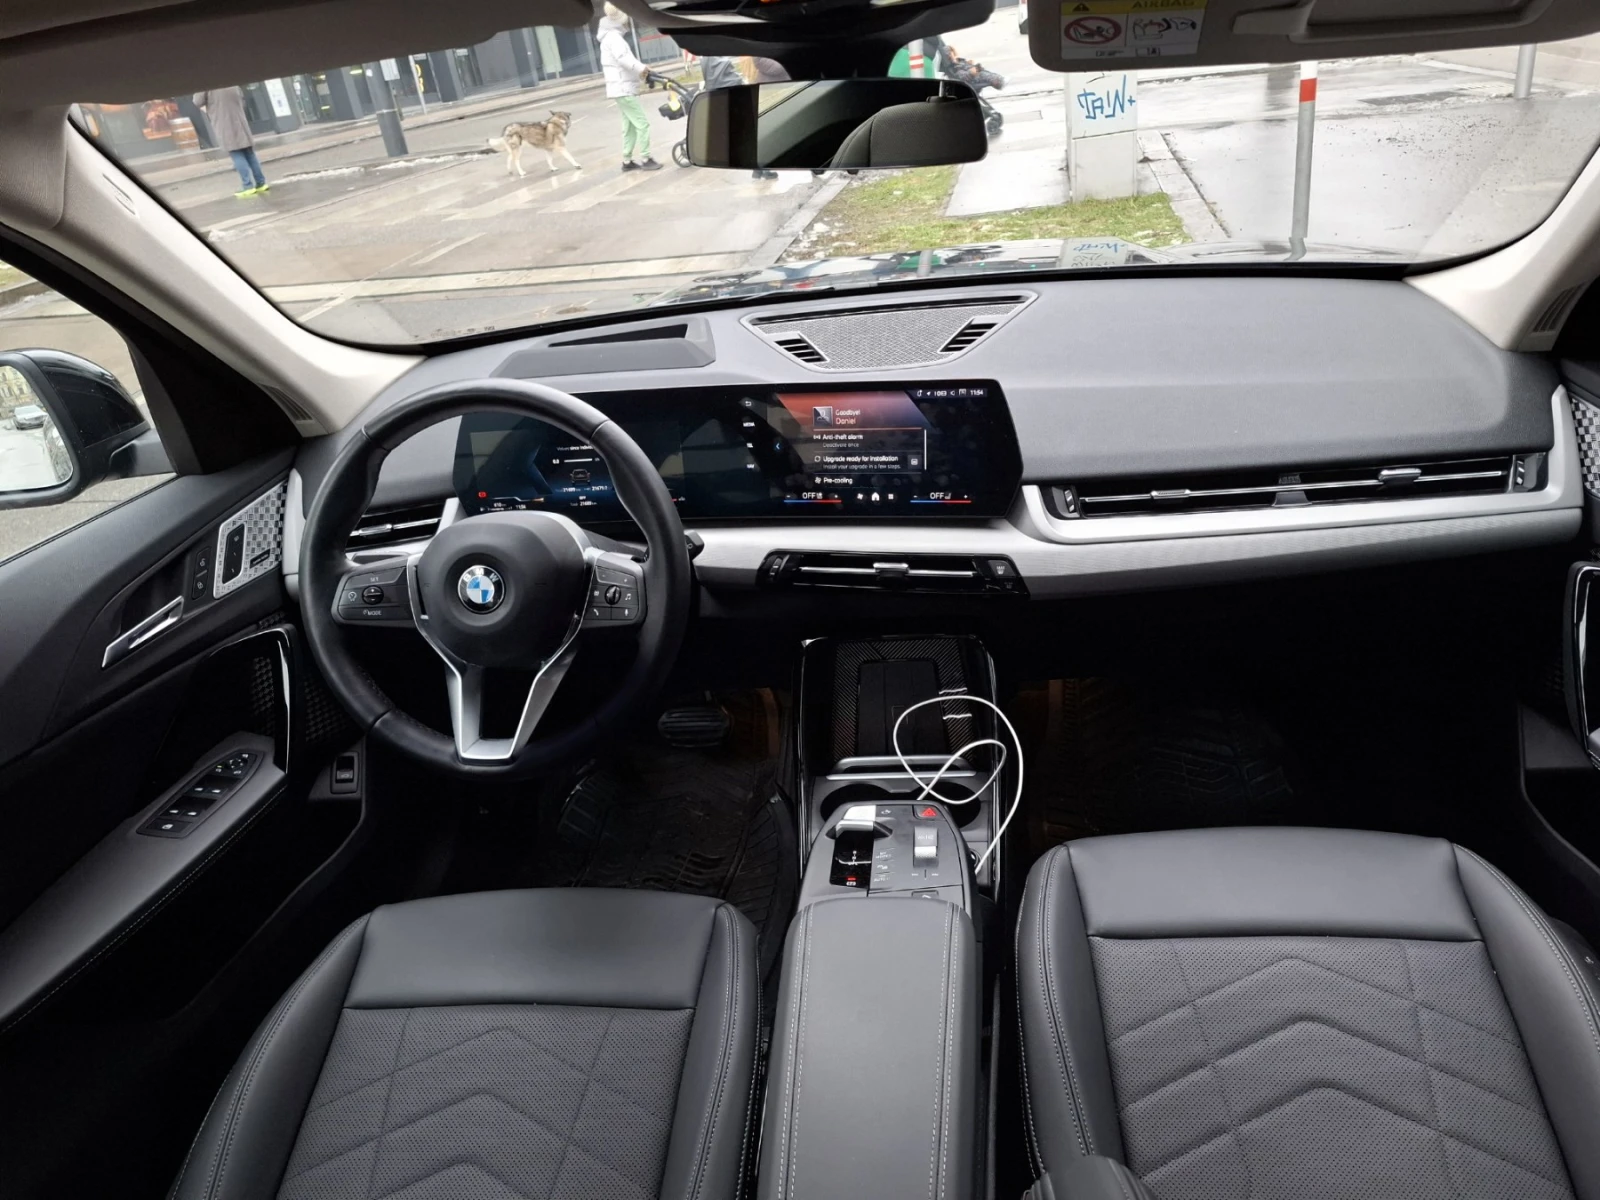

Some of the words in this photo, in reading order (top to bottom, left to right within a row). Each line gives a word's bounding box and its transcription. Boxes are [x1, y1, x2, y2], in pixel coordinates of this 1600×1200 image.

[835, 417, 857, 425] Daniel
[823, 477, 853, 485] Pre-cooling
[463, 567, 499, 582] BMW
